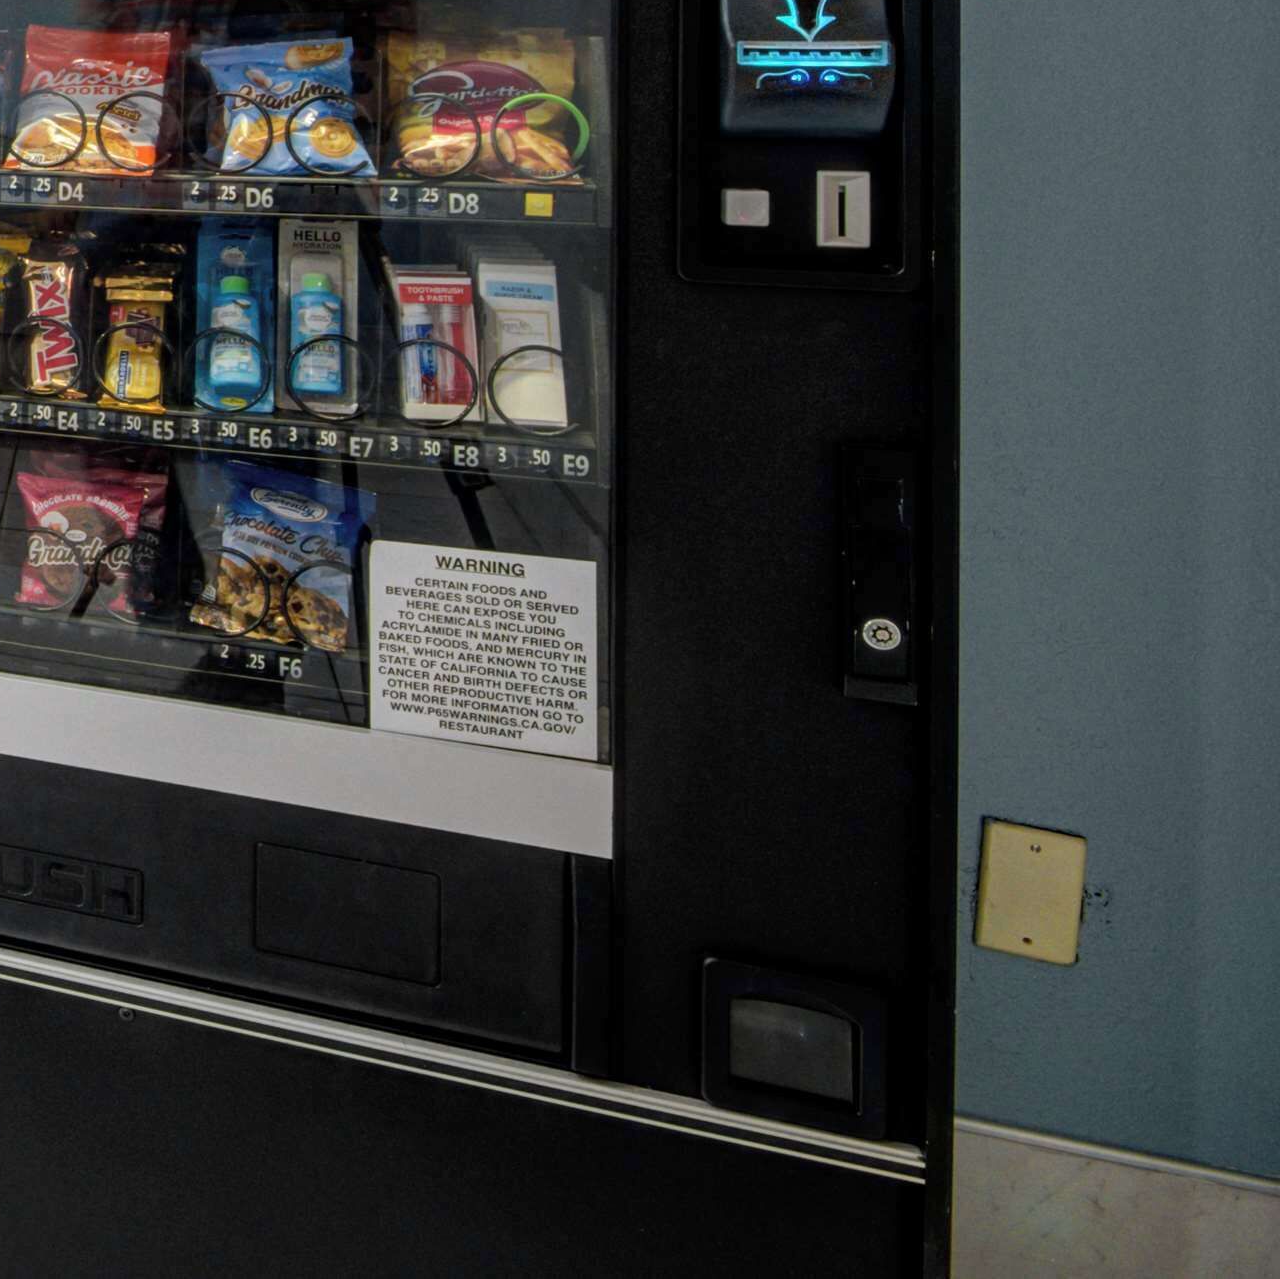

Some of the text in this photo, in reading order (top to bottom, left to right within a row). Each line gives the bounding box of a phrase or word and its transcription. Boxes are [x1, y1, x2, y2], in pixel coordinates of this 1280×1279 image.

[246, 188, 273, 208] D6
[390, 187, 398, 201] 2
[449, 194, 479, 213] D8
[294, 230, 341, 242] HELLO
[407, 287, 464, 295] TOOTHBRUSH
[28, 281, 79, 386] TWIX
[153, 422, 174, 440] E5
[217, 423, 272, 448] .50 E6
[390, 437, 479, 467] 3 .50 E8
[563, 455, 590, 476] E9
[435, 555, 526, 577] WARNING
[415, 577, 548, 600] CERTAIN FOODS AND
[385, 586, 579, 615] BEVERAGES SOLD OR SERVED
[407, 599, 557, 625] HERE CAN EXPOSE YOU
[279, 658, 302, 679] F6
[378, 665, 588, 700] CANCER AND BIRTH DEFECTS OR
[390, 702, 576, 735] WWW.P65WARNINGS.CA.GOV/
[439, 720, 525, 739] RESTAURANT
